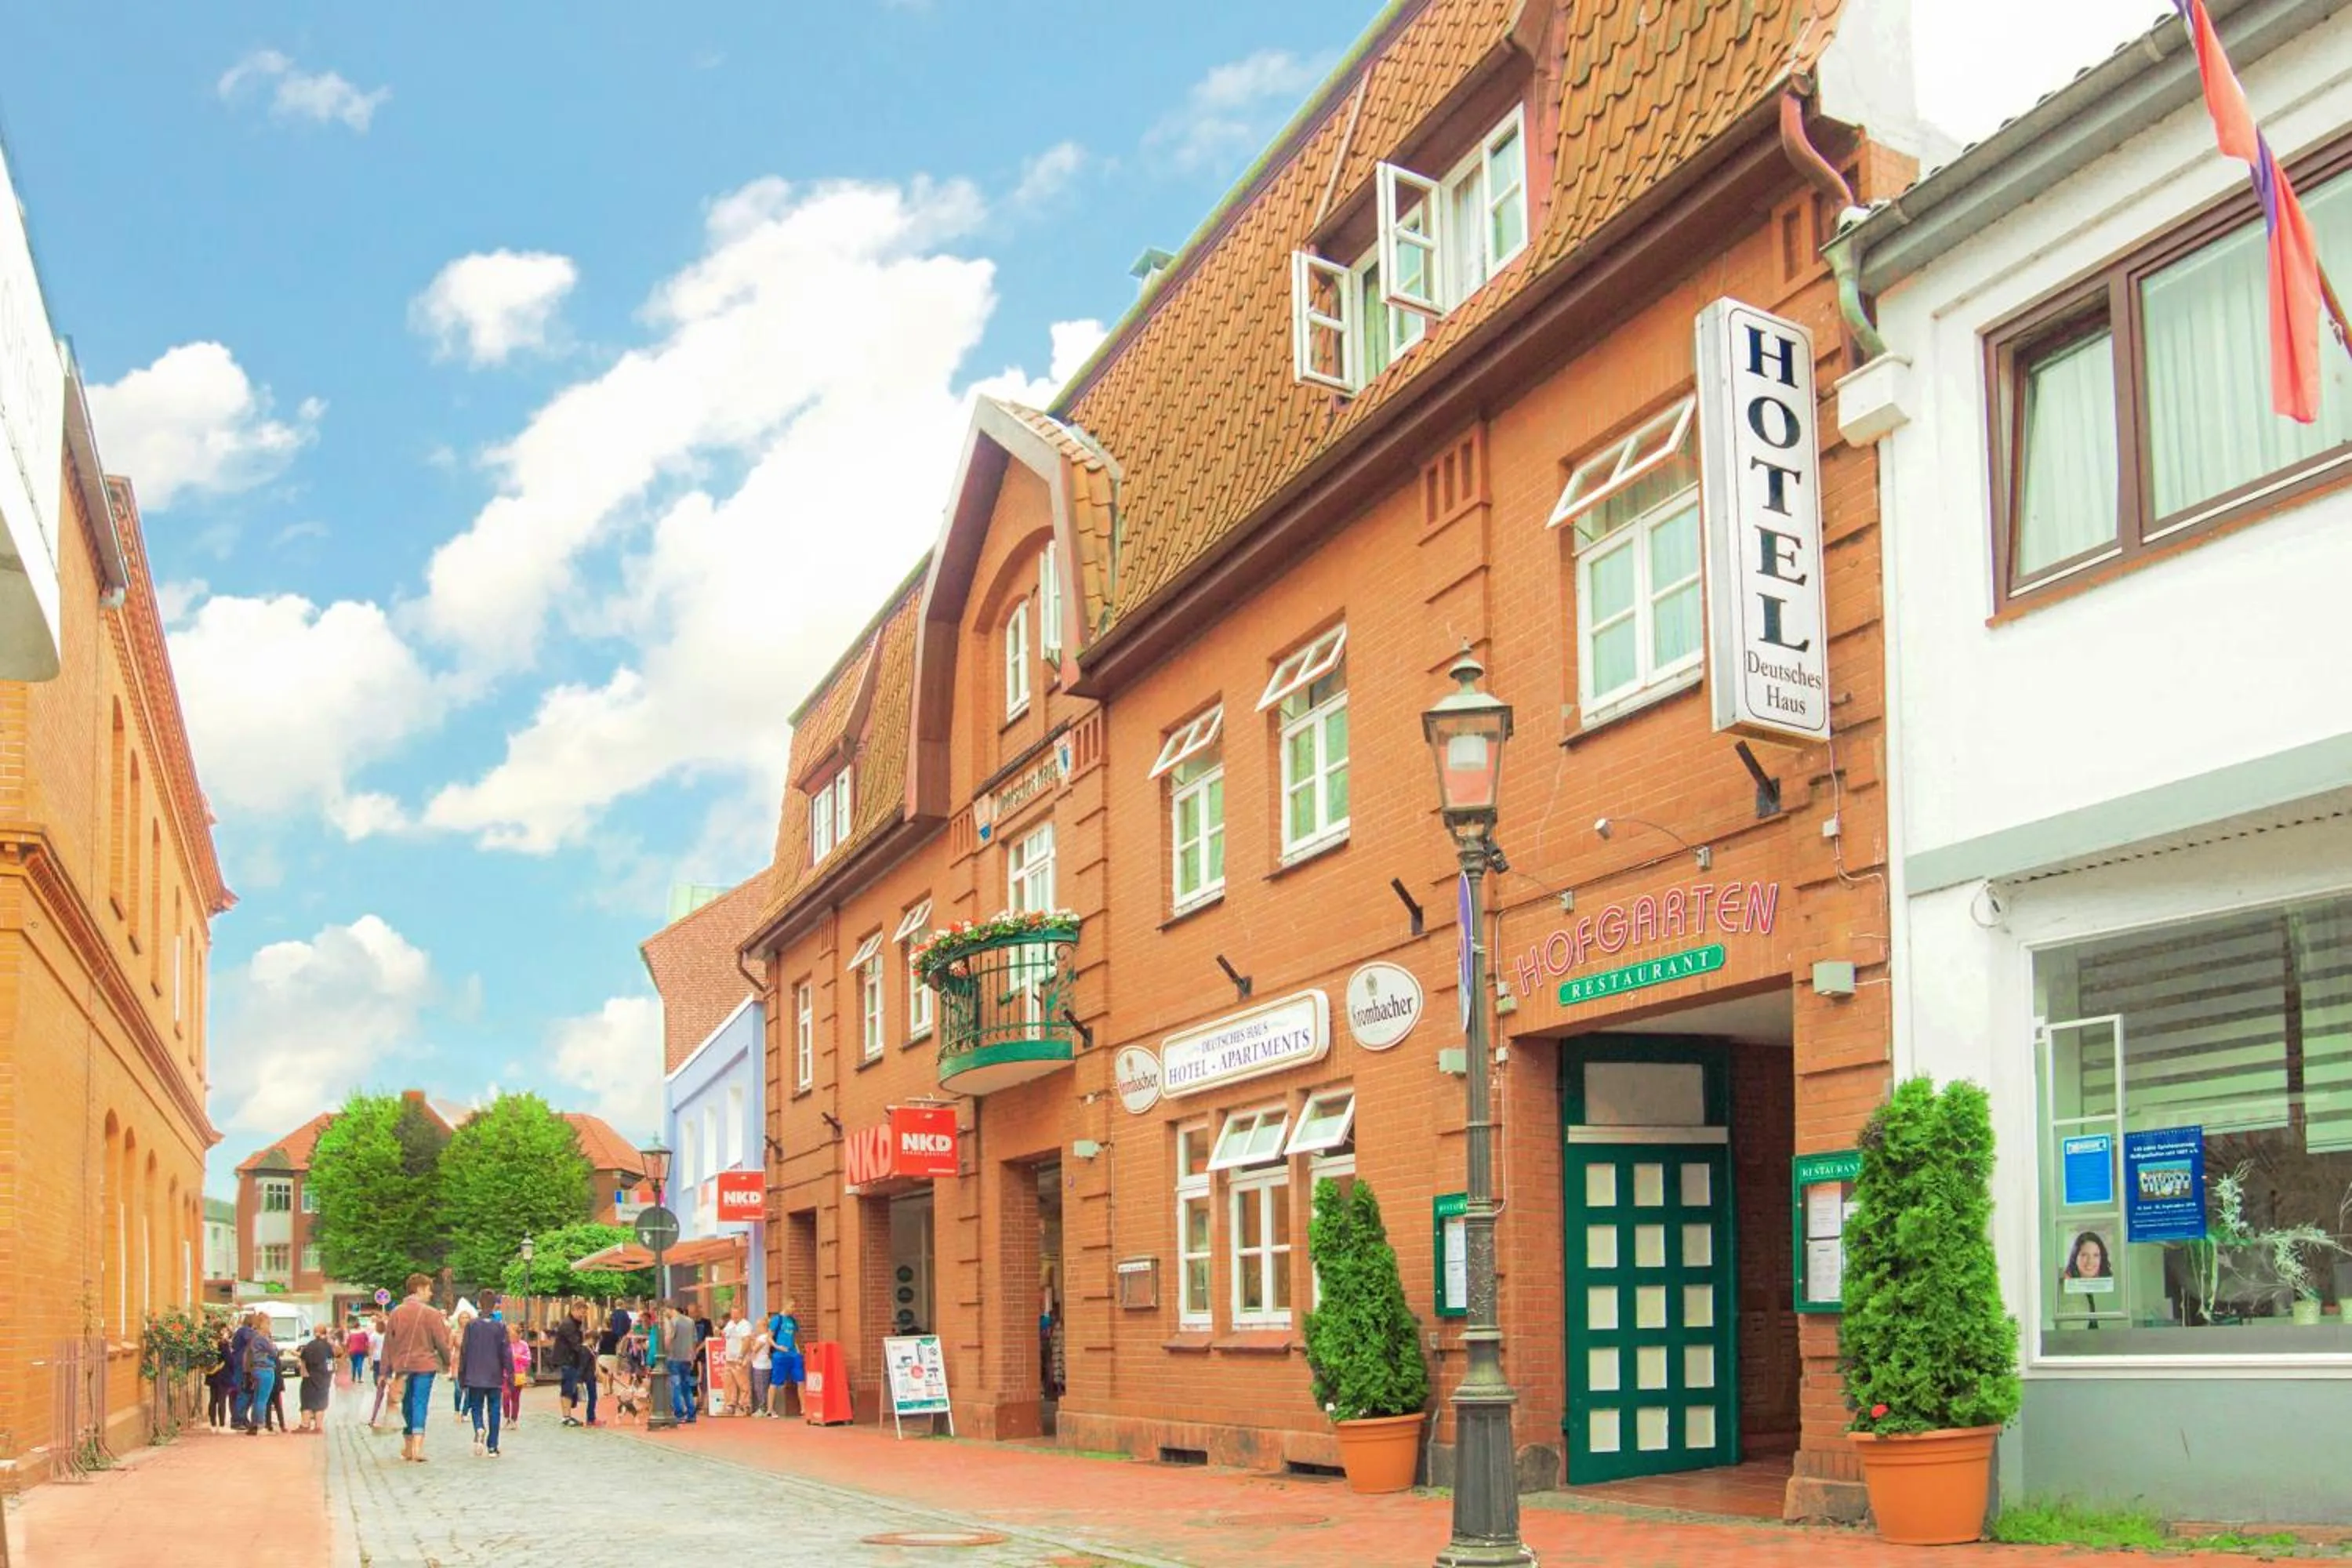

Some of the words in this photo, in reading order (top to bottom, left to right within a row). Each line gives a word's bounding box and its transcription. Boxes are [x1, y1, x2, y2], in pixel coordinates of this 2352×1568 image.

[1744, 323, 1810, 653] HOTEL
[1748, 650, 1821, 690] Deutsches
[1766, 684, 1806, 715] Haus
[1515, 881, 1779, 996] HOFGARTEN
[1571, 950, 1711, 999] RESTAURANT
[1169, 1059, 1208, 1084] HOTEL
[1220, 1028, 1310, 1071] APARTMENTS
[845, 1124, 891, 1185] NKD
[901, 1132, 952, 1152] NKD
[723, 1191, 761, 1205] NKD
